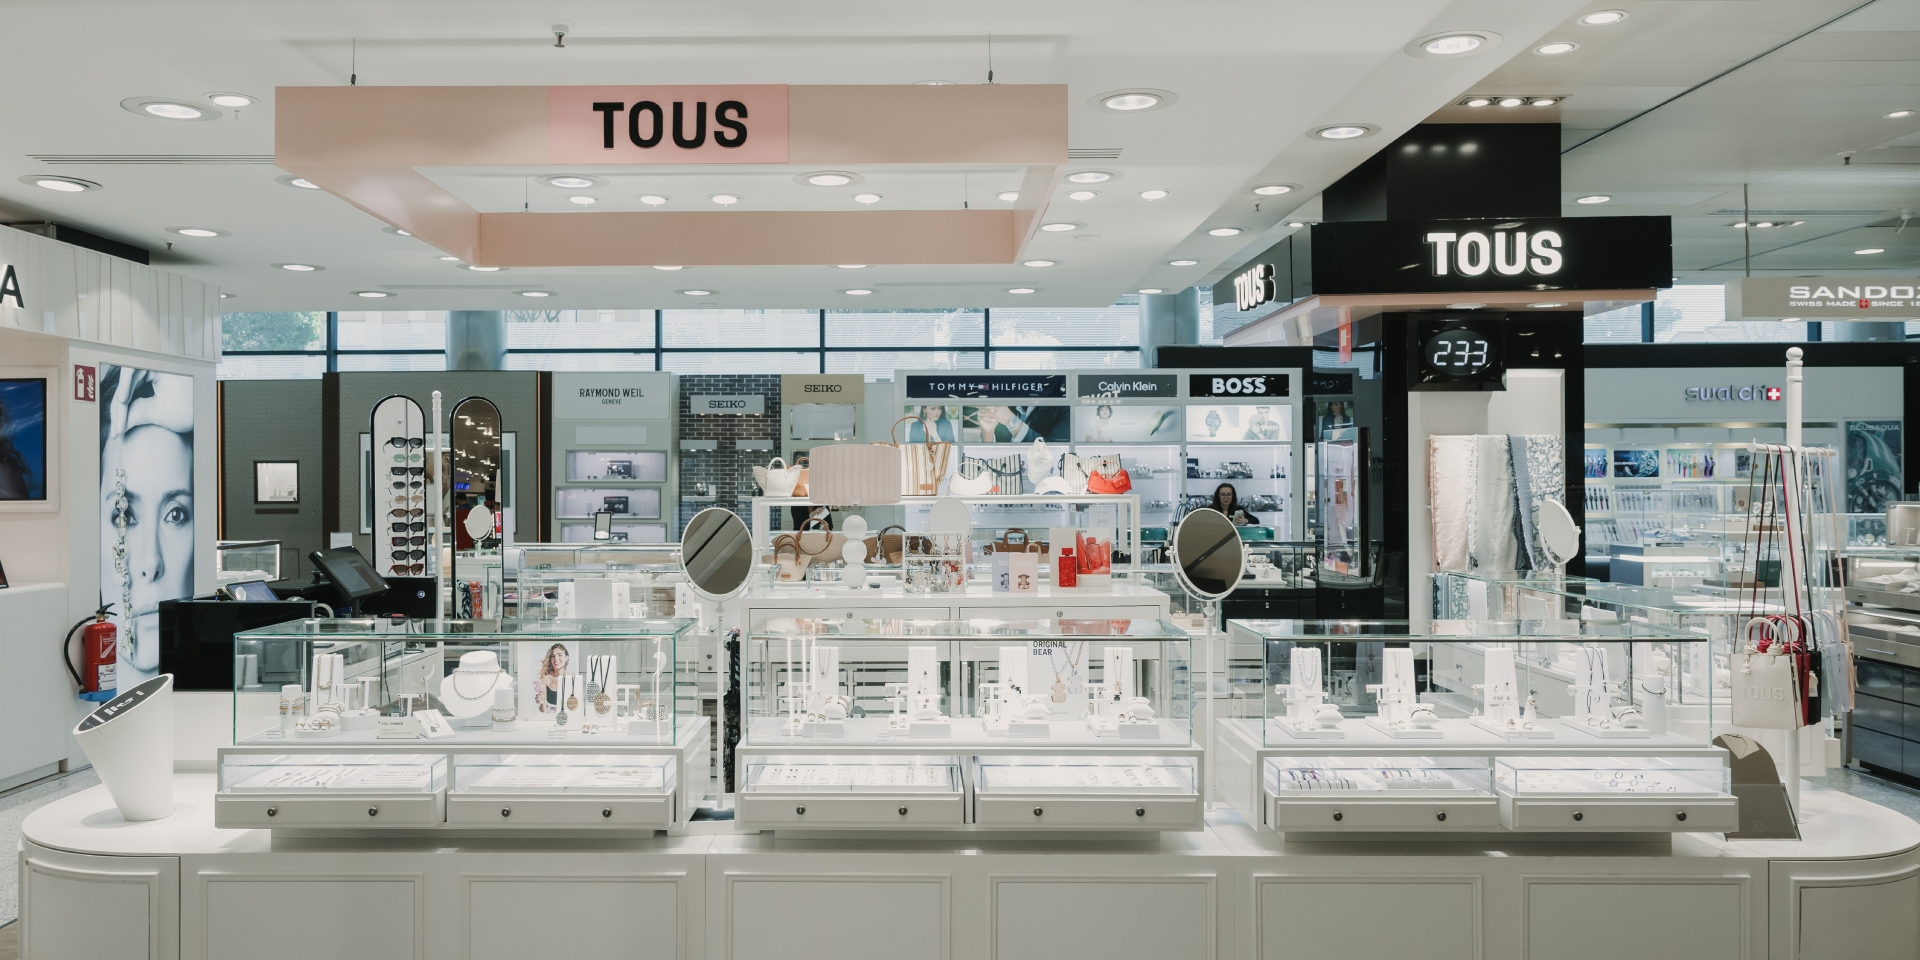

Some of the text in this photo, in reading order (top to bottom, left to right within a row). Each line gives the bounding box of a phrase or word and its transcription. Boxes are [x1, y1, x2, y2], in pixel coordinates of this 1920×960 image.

[593, 100, 748, 149] TOUS
[1425, 231, 1564, 277] TOUS
[1234, 264, 1268, 313] TOUS
[1789, 285, 1920, 300] SANDO
[579, 388, 644, 397] RAYMOND WEIL
[804, 384, 842, 393] SEIKO
[929, 383, 1043, 391] TOMMY HILFIGER
[1098, 381, 1157, 391] Calvin Klein
[1212, 377, 1267, 394] BOSS
[1685, 385, 1768, 401] swatch
[708, 400, 746, 408] SEIKO
[1740, 685, 1785, 701] TOUS
